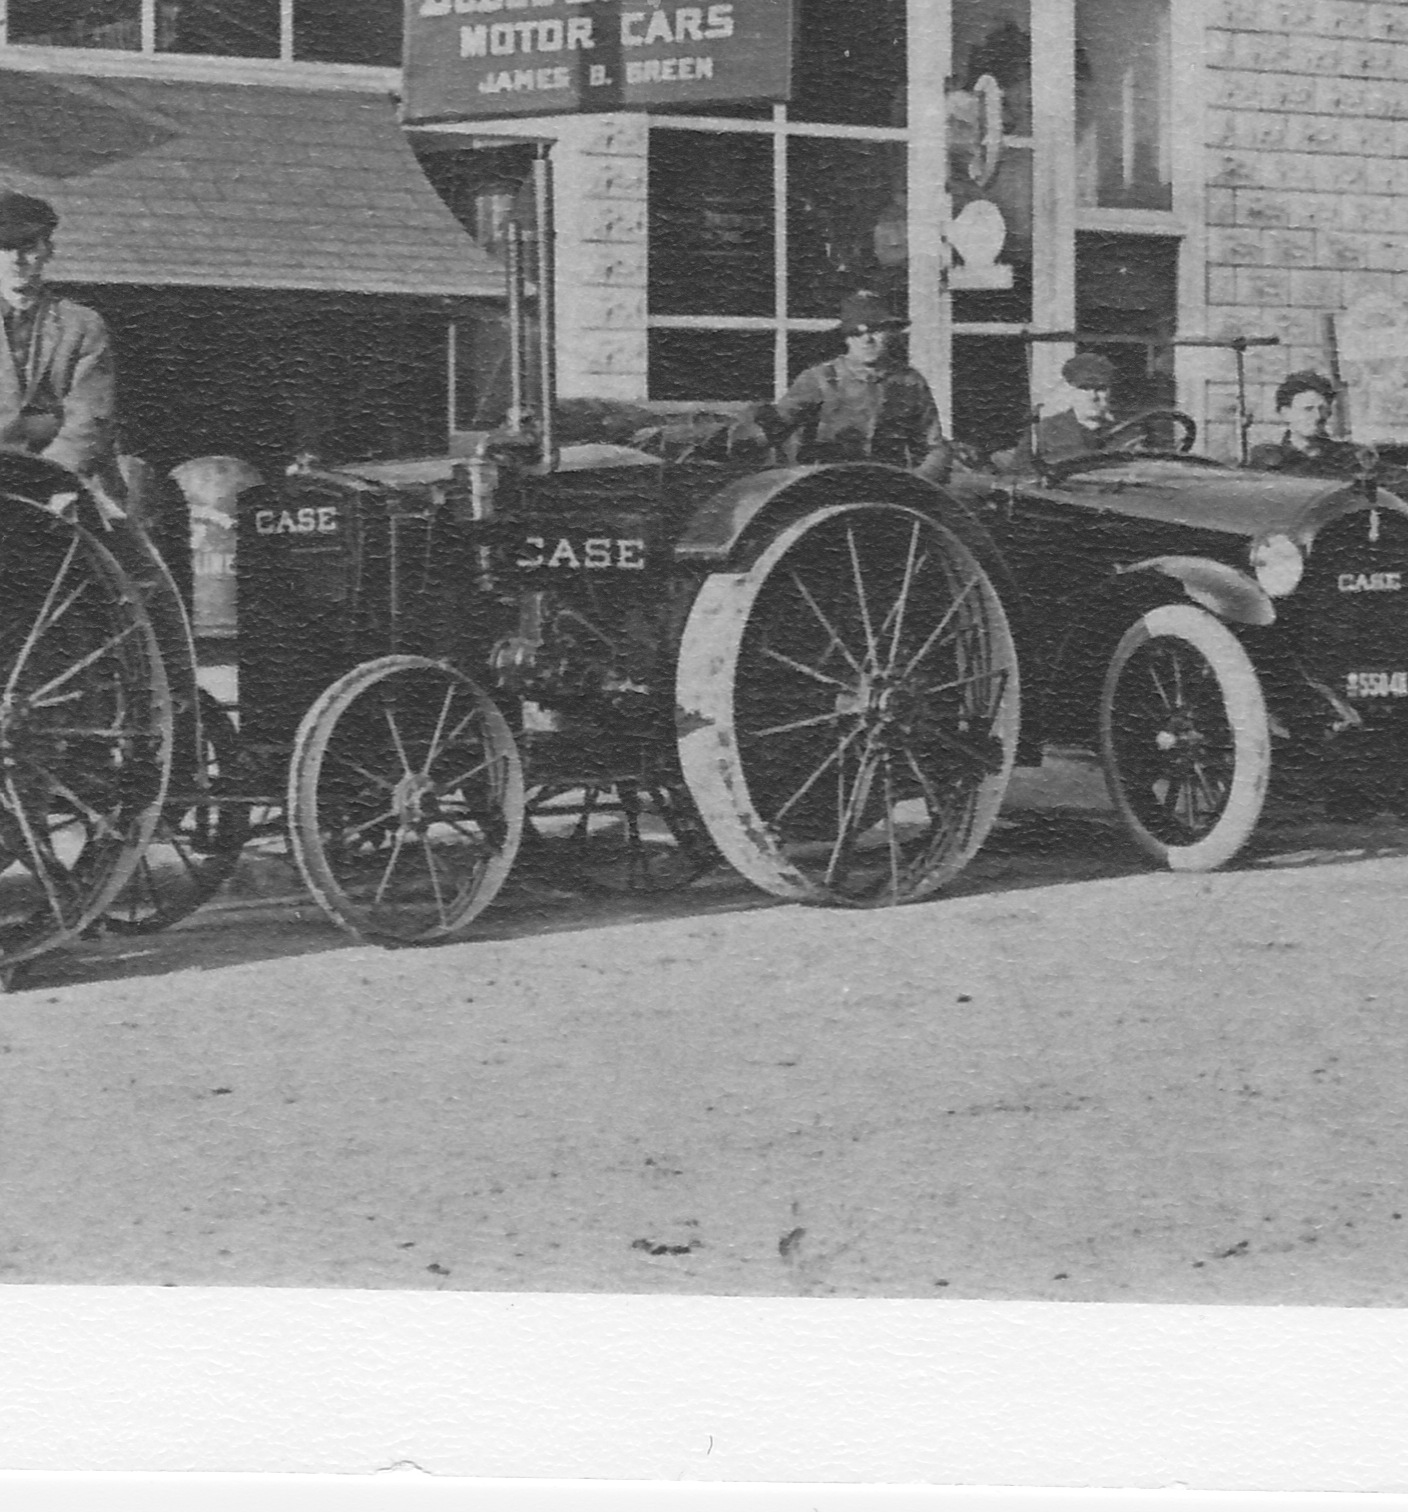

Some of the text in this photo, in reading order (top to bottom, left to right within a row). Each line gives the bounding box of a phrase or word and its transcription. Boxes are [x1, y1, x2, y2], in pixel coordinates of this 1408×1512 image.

[459, 4, 735, 58] MOTOR CARS
[478, 66, 571, 94] JAMES
[625, 56, 714, 85] GREEN
[255, 506, 337, 534] CASE
[1338, 571, 1402, 592] CASE
